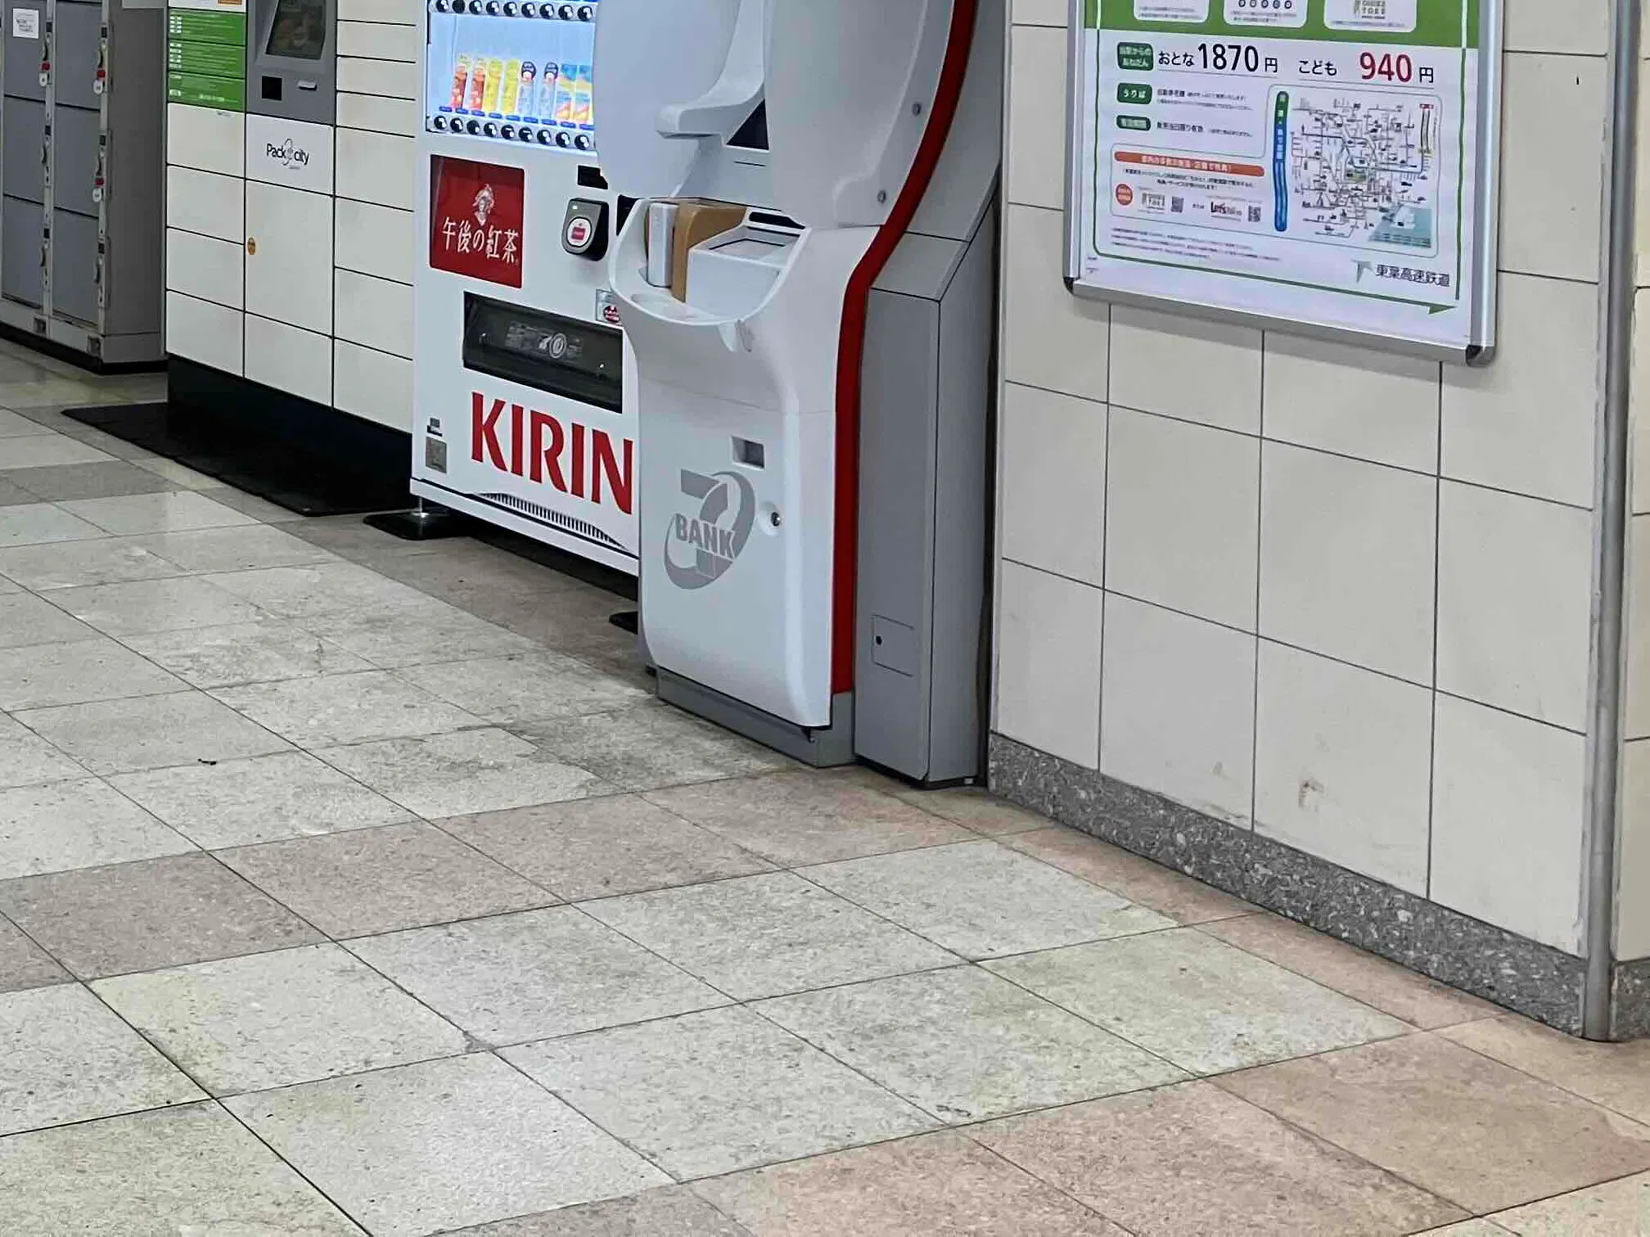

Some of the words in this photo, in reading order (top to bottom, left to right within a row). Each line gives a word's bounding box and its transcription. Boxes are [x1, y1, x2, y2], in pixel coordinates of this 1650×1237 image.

[1158, 50, 1195, 67] おとな
[1198, 43, 1259, 72] 1870
[1299, 59, 1337, 76] こども
[1359, 51, 1413, 83] 940
[266, 143, 287, 159] Pack
[442, 216, 519, 263] 午後の紅茶
[1376, 264, 1450, 288] 東葉高速鉄道
[471, 391, 633, 515] KIRIN
[675, 512, 735, 560] BANK
